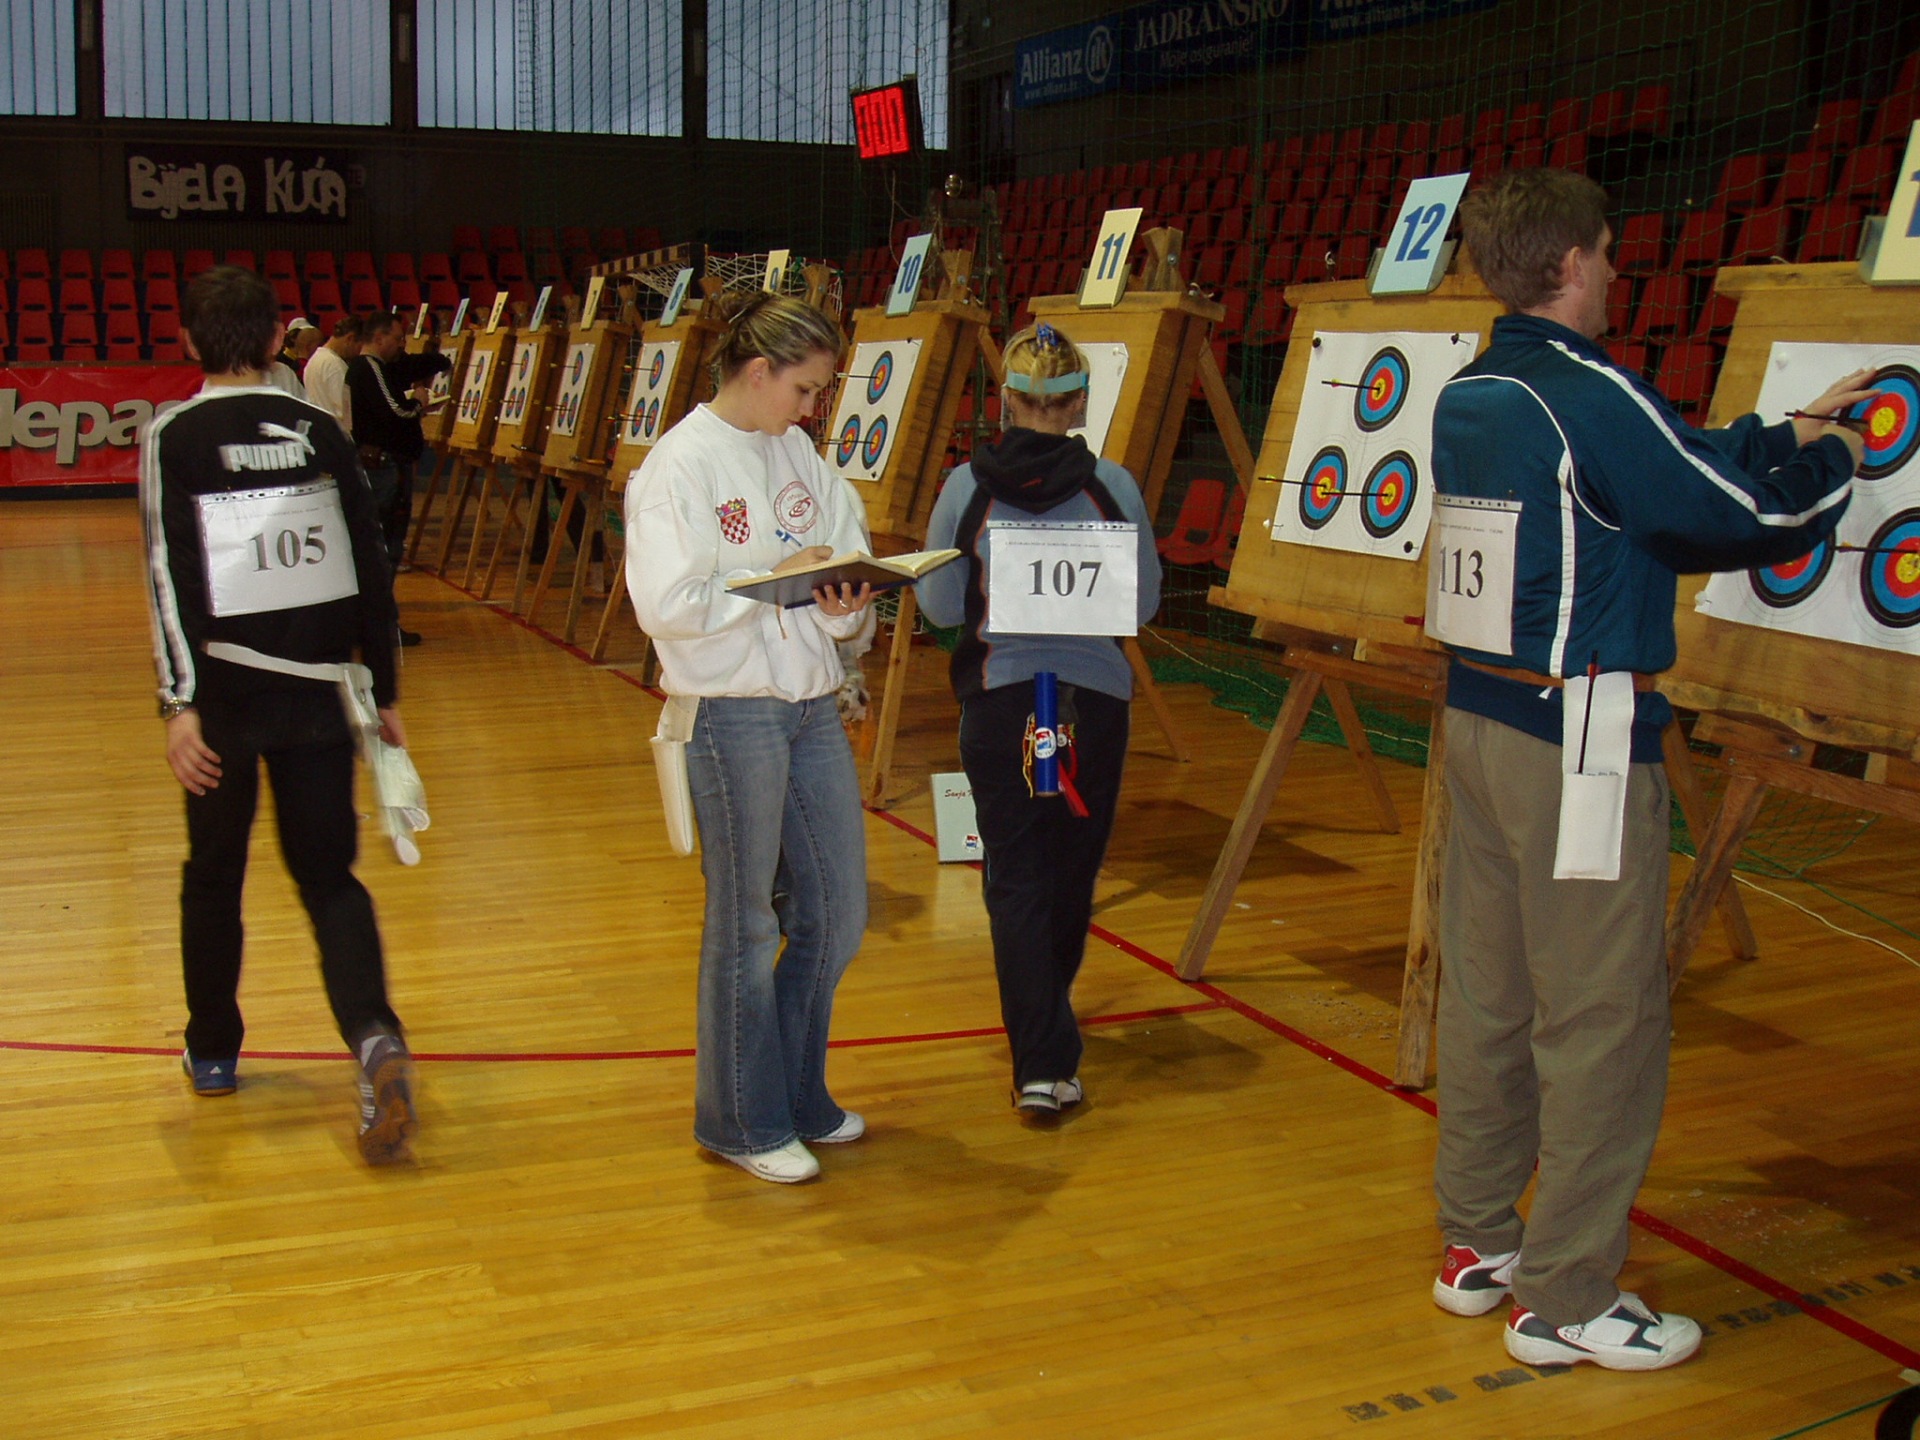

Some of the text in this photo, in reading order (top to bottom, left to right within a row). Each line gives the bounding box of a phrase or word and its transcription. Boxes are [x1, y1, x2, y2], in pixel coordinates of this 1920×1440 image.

[1020, 45, 1083, 86] Allianz
[1395, 203, 1447, 262] 12
[897, 253, 922, 295] 10
[1096, 232, 1126, 281] 11
[0, 388, 183, 465] lepa
[218, 440, 307, 472] PUMA
[249, 525, 327, 572] 105
[1439, 545, 1484, 599] 113
[1028, 558, 1103, 598] 107
